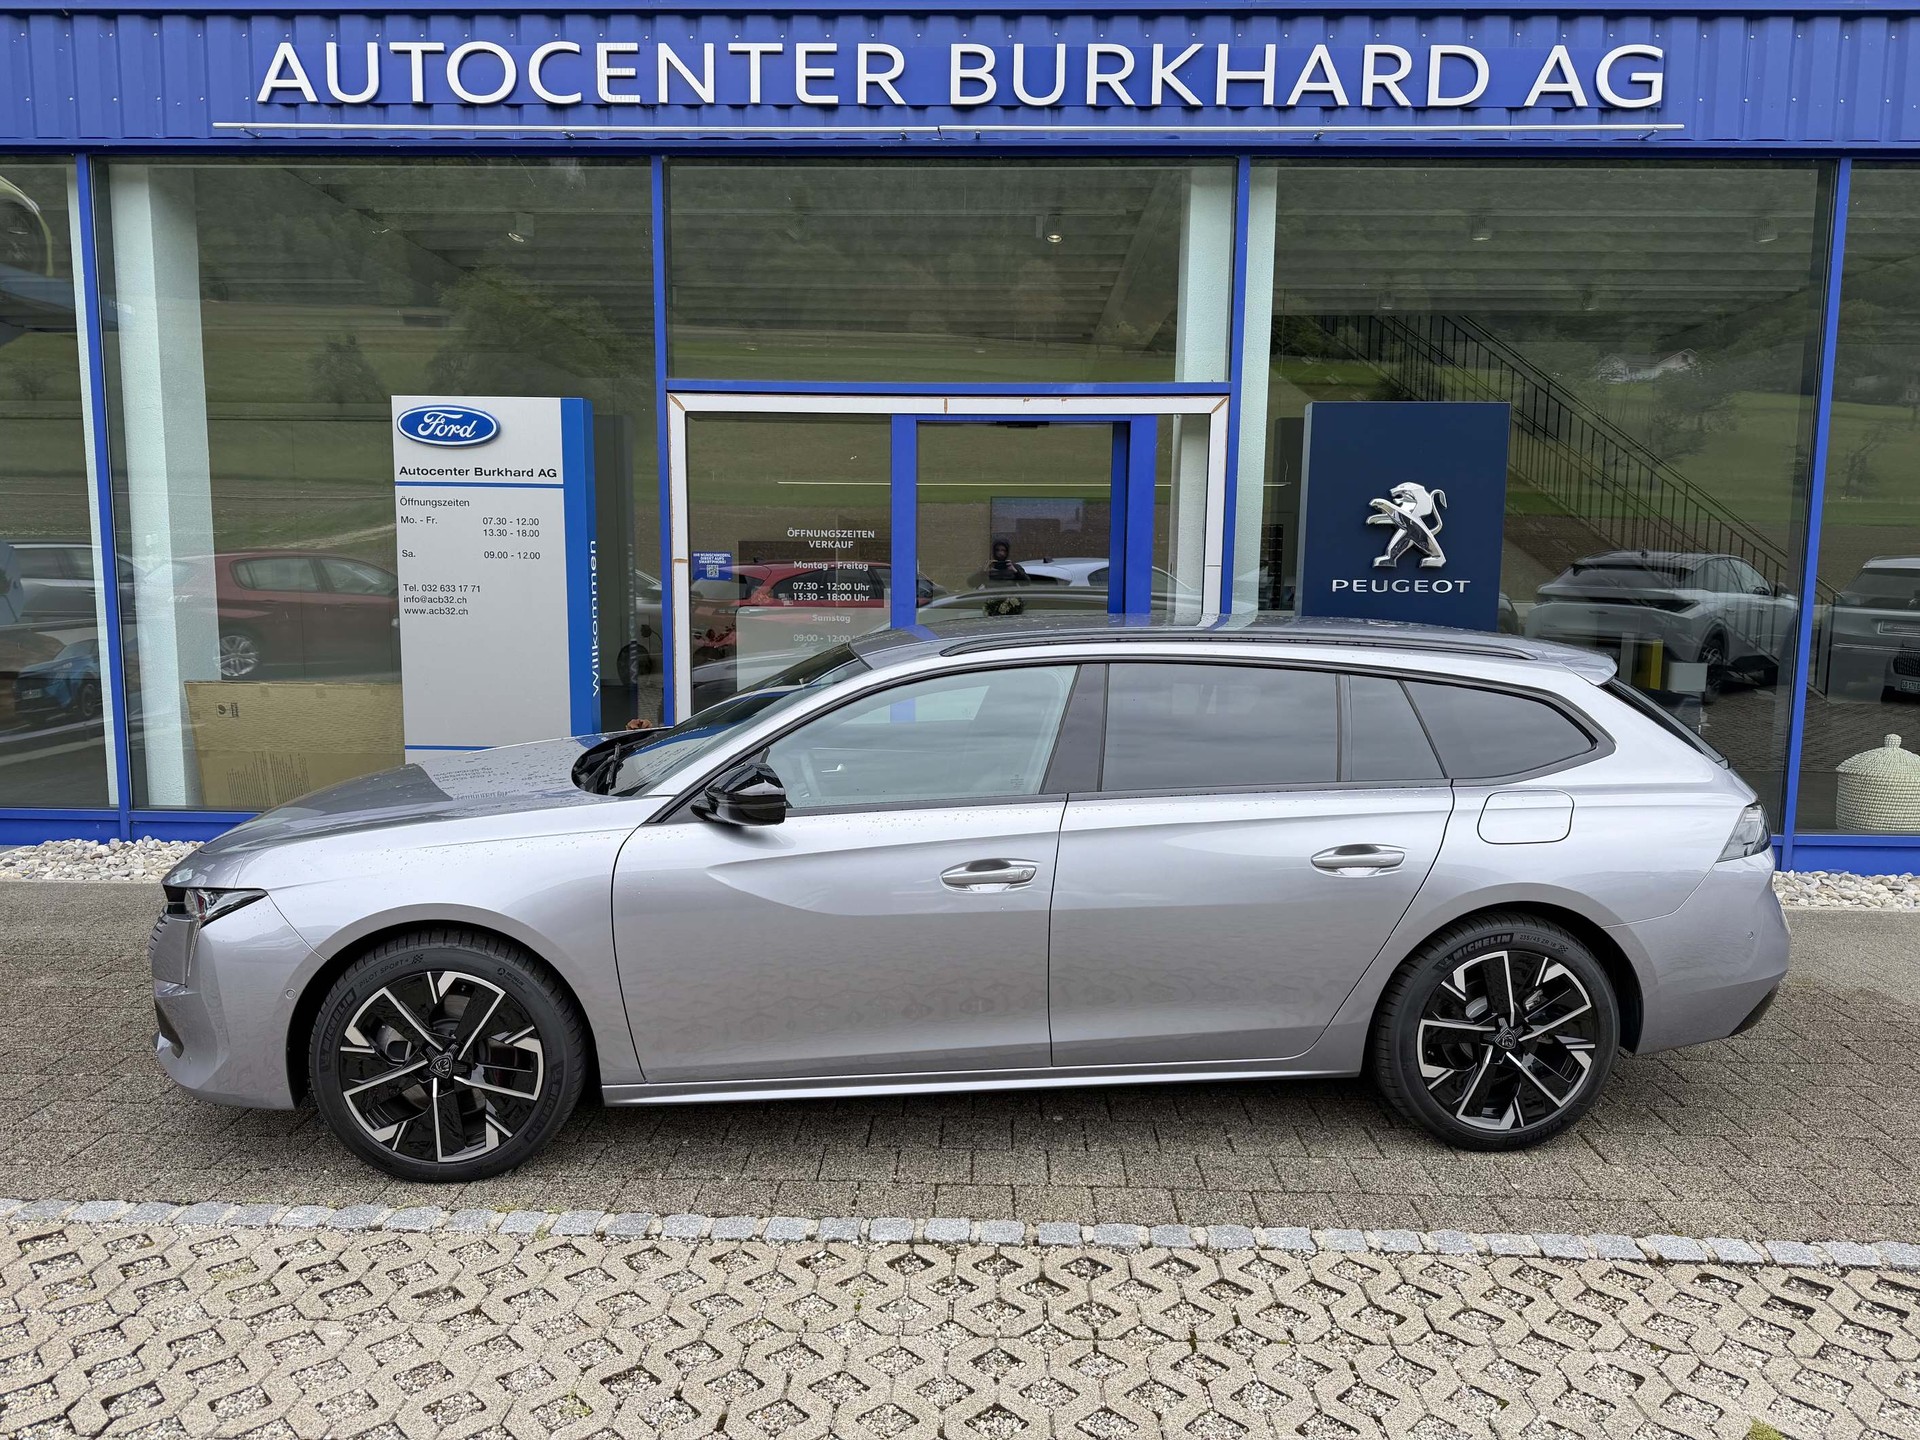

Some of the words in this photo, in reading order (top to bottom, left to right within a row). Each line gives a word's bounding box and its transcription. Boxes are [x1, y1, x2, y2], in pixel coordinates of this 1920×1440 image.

[256, 41, 906, 105] AUTOCENTER
[949, 43, 1491, 106] BURKHARD
[1523, 44, 1664, 107] AG
[417, 411, 477, 437] Ford
[399, 466, 470, 477] Autocenter
[474, 467, 534, 478] Burkhard
[537, 468, 557, 478] AG
[399, 496, 470, 508] Öffnungszeiten
[400, 516, 418, 524] Mo.
[426, 516, 438, 525] Fr.
[482, 517, 507, 526] 07.30
[516, 517, 540, 526] 12.00
[483, 529, 507, 537] 13.30
[516, 529, 540, 538] 18.00
[787, 527, 875, 539] ÖFFNUNGSZEITEN
[808, 540, 854, 549] VERKAUF
[401, 549, 416, 558] Sa.
[484, 551, 508, 560] 09.00
[517, 552, 541, 560] 12.00
[793, 561, 828, 571] Montag
[837, 561, 869, 571] Freitag
[403, 584, 419, 592] Tel.
[421, 584, 437, 593] 032
[440, 584, 456, 593] 633
[459, 585, 468, 593] 17
[470, 585, 481, 593] 71
[793, 582, 818, 590] 07:30
[827, 583, 852, 591] 12:00
[854, 583, 870, 591] Uhr
[1331, 579, 1471, 594] PEUGEOT
[403, 595, 467, 605] info@acb32.ch
[793, 593, 818, 601] 13:30
[827, 593, 852, 601] 18:00
[854, 594, 870, 602] Uhr
[404, 607, 469, 616] www.acb32.ch
[590, 540, 600, 697] Willkommen
[812, 614, 851, 623] Samstag
[793, 634, 818, 642] 09:00
[1453, 934, 1512, 961] MICHELIN
[359, 973, 378, 987] PILOT
[380, 960, 403, 974] SPORT
